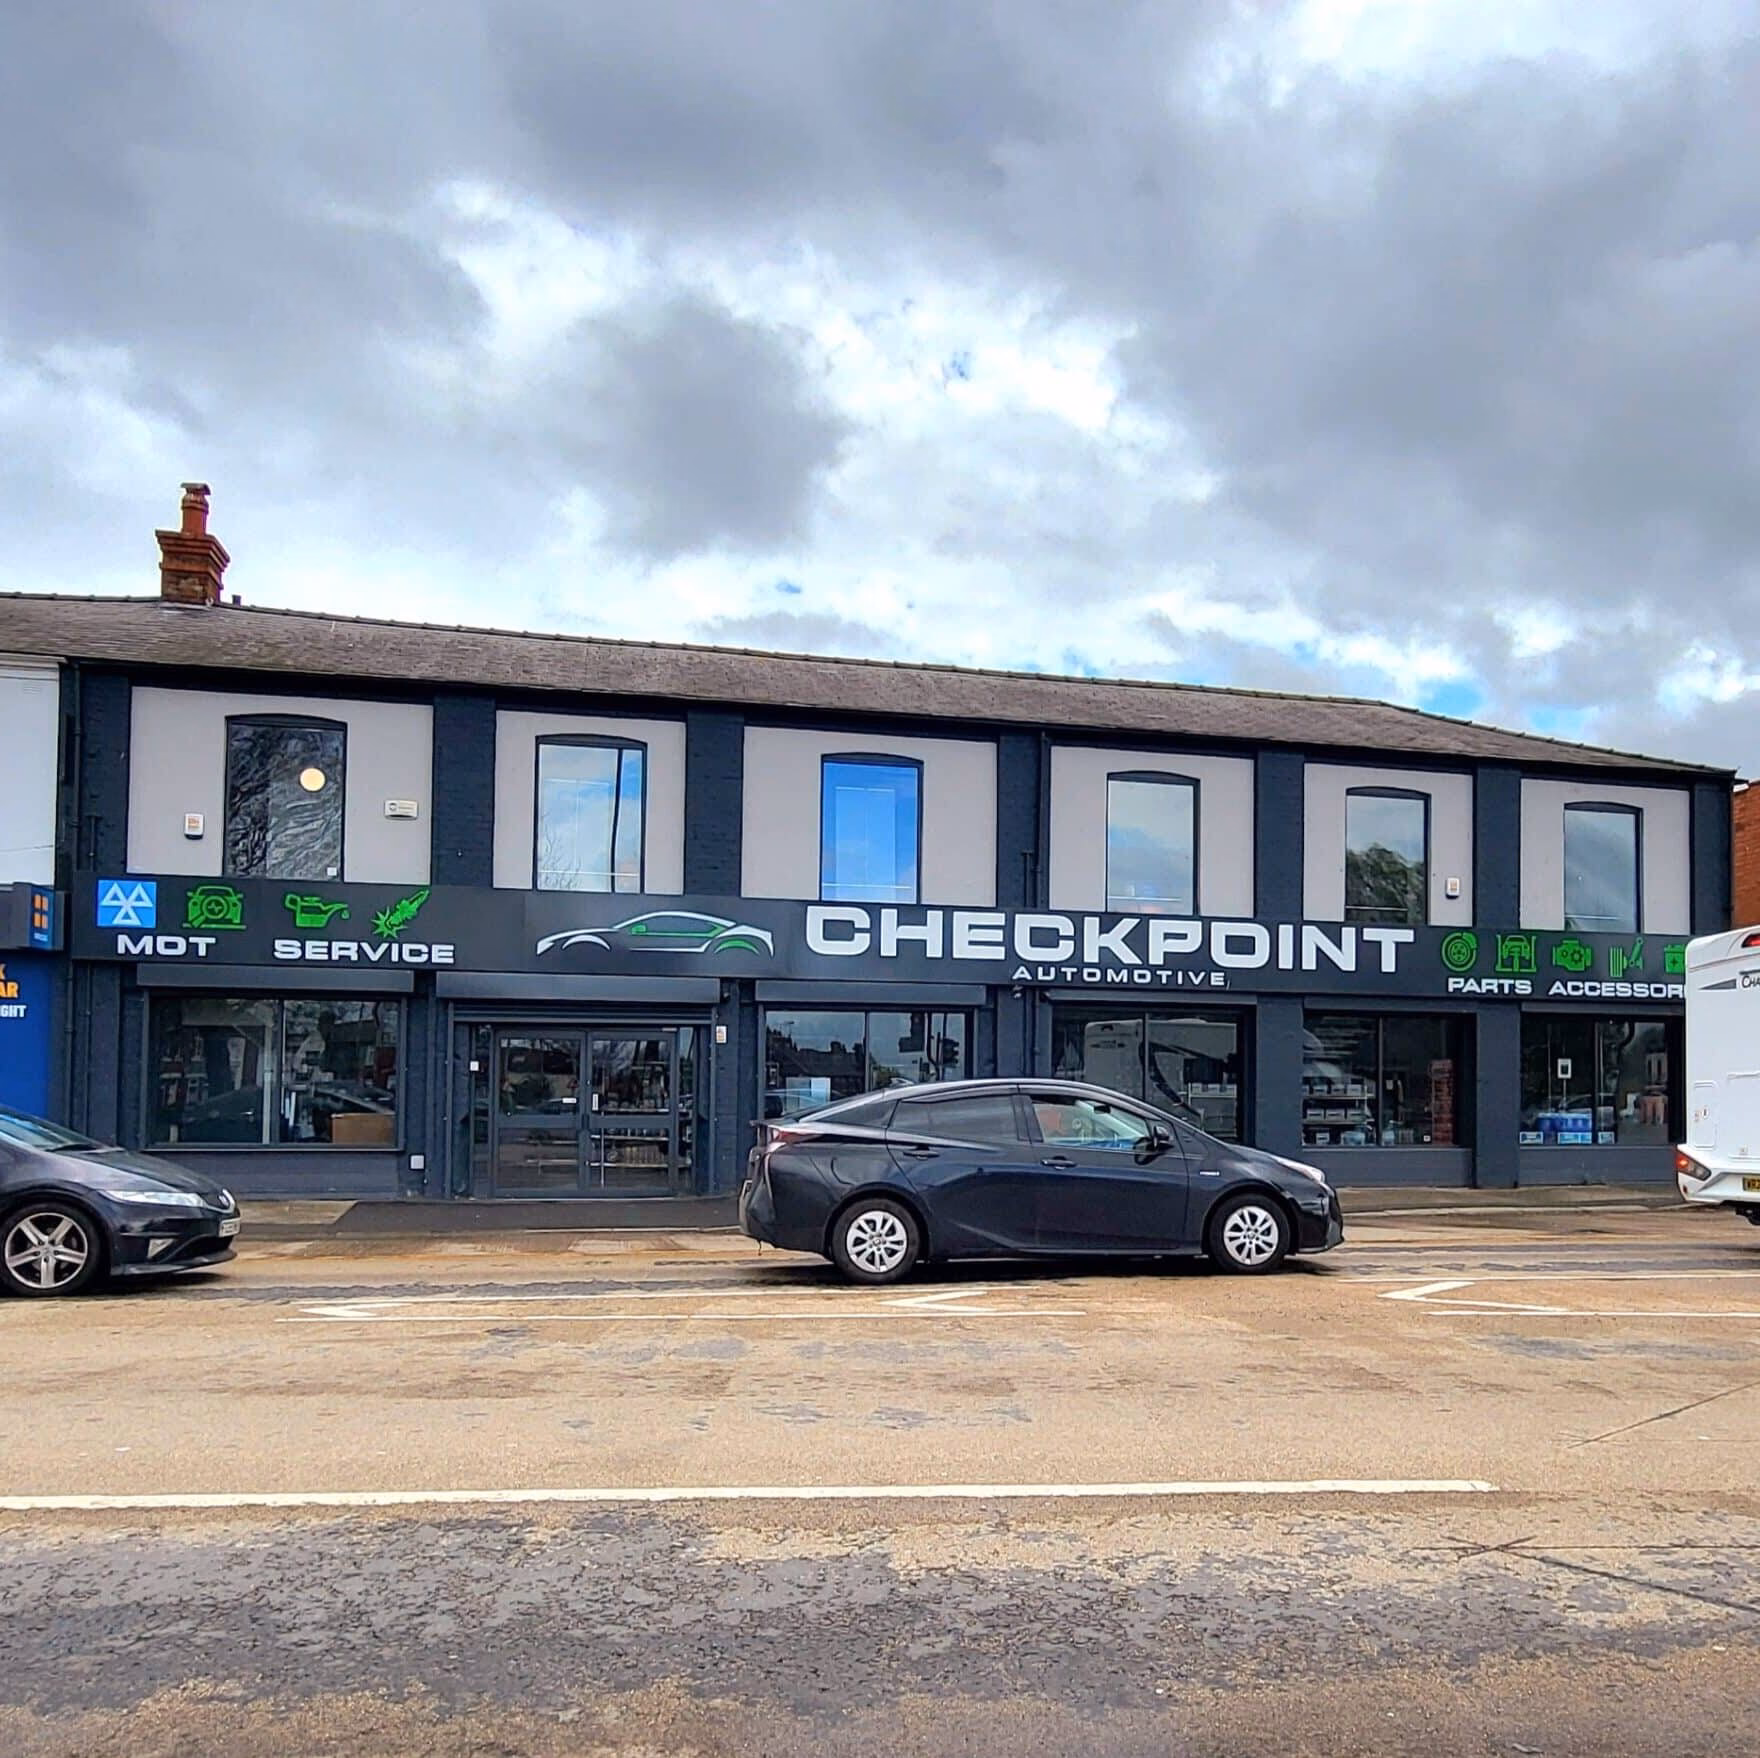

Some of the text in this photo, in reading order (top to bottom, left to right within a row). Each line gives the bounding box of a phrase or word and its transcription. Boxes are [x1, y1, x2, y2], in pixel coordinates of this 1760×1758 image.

[117, 934, 455, 964] MOT SERVICE
[805, 905, 1415, 973] CHECKPOINT
[1011, 966, 1226, 987] AUTOMOTIVE
[1448, 977, 1532, 995] PARTS
